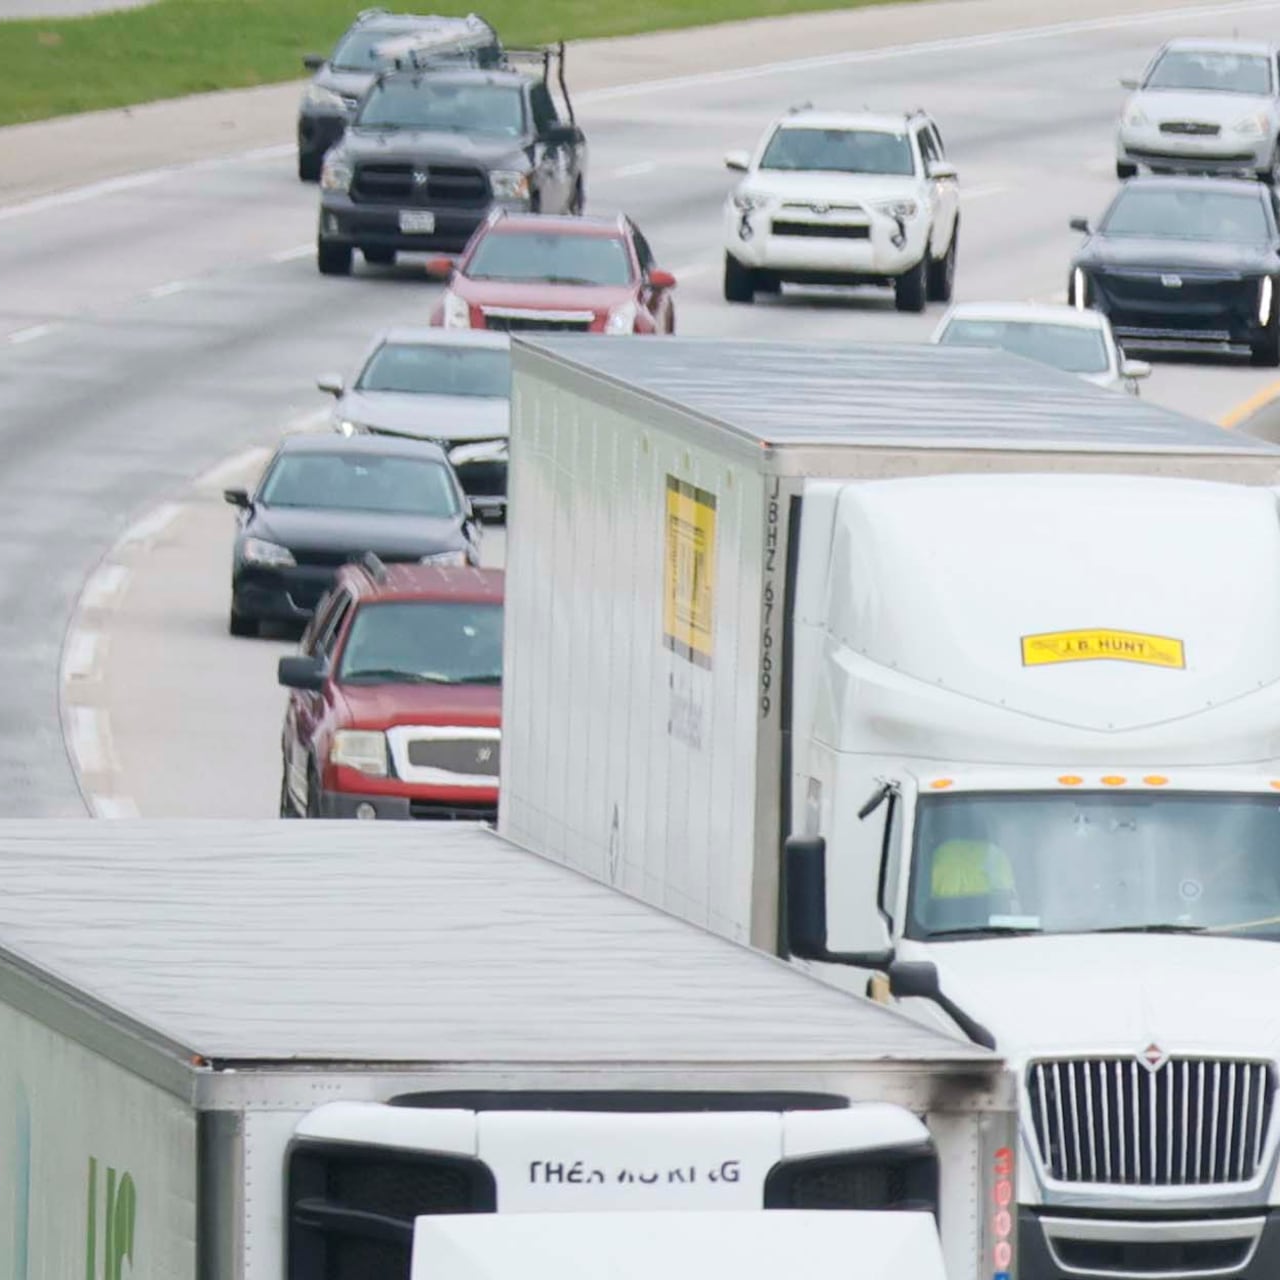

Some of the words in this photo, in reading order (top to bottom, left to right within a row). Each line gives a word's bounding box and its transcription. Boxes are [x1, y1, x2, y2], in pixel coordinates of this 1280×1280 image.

[1098, 639, 1145, 654] HUNT
[529, 1160, 659, 1184] THE
[668, 1160, 741, 1184] KIG
